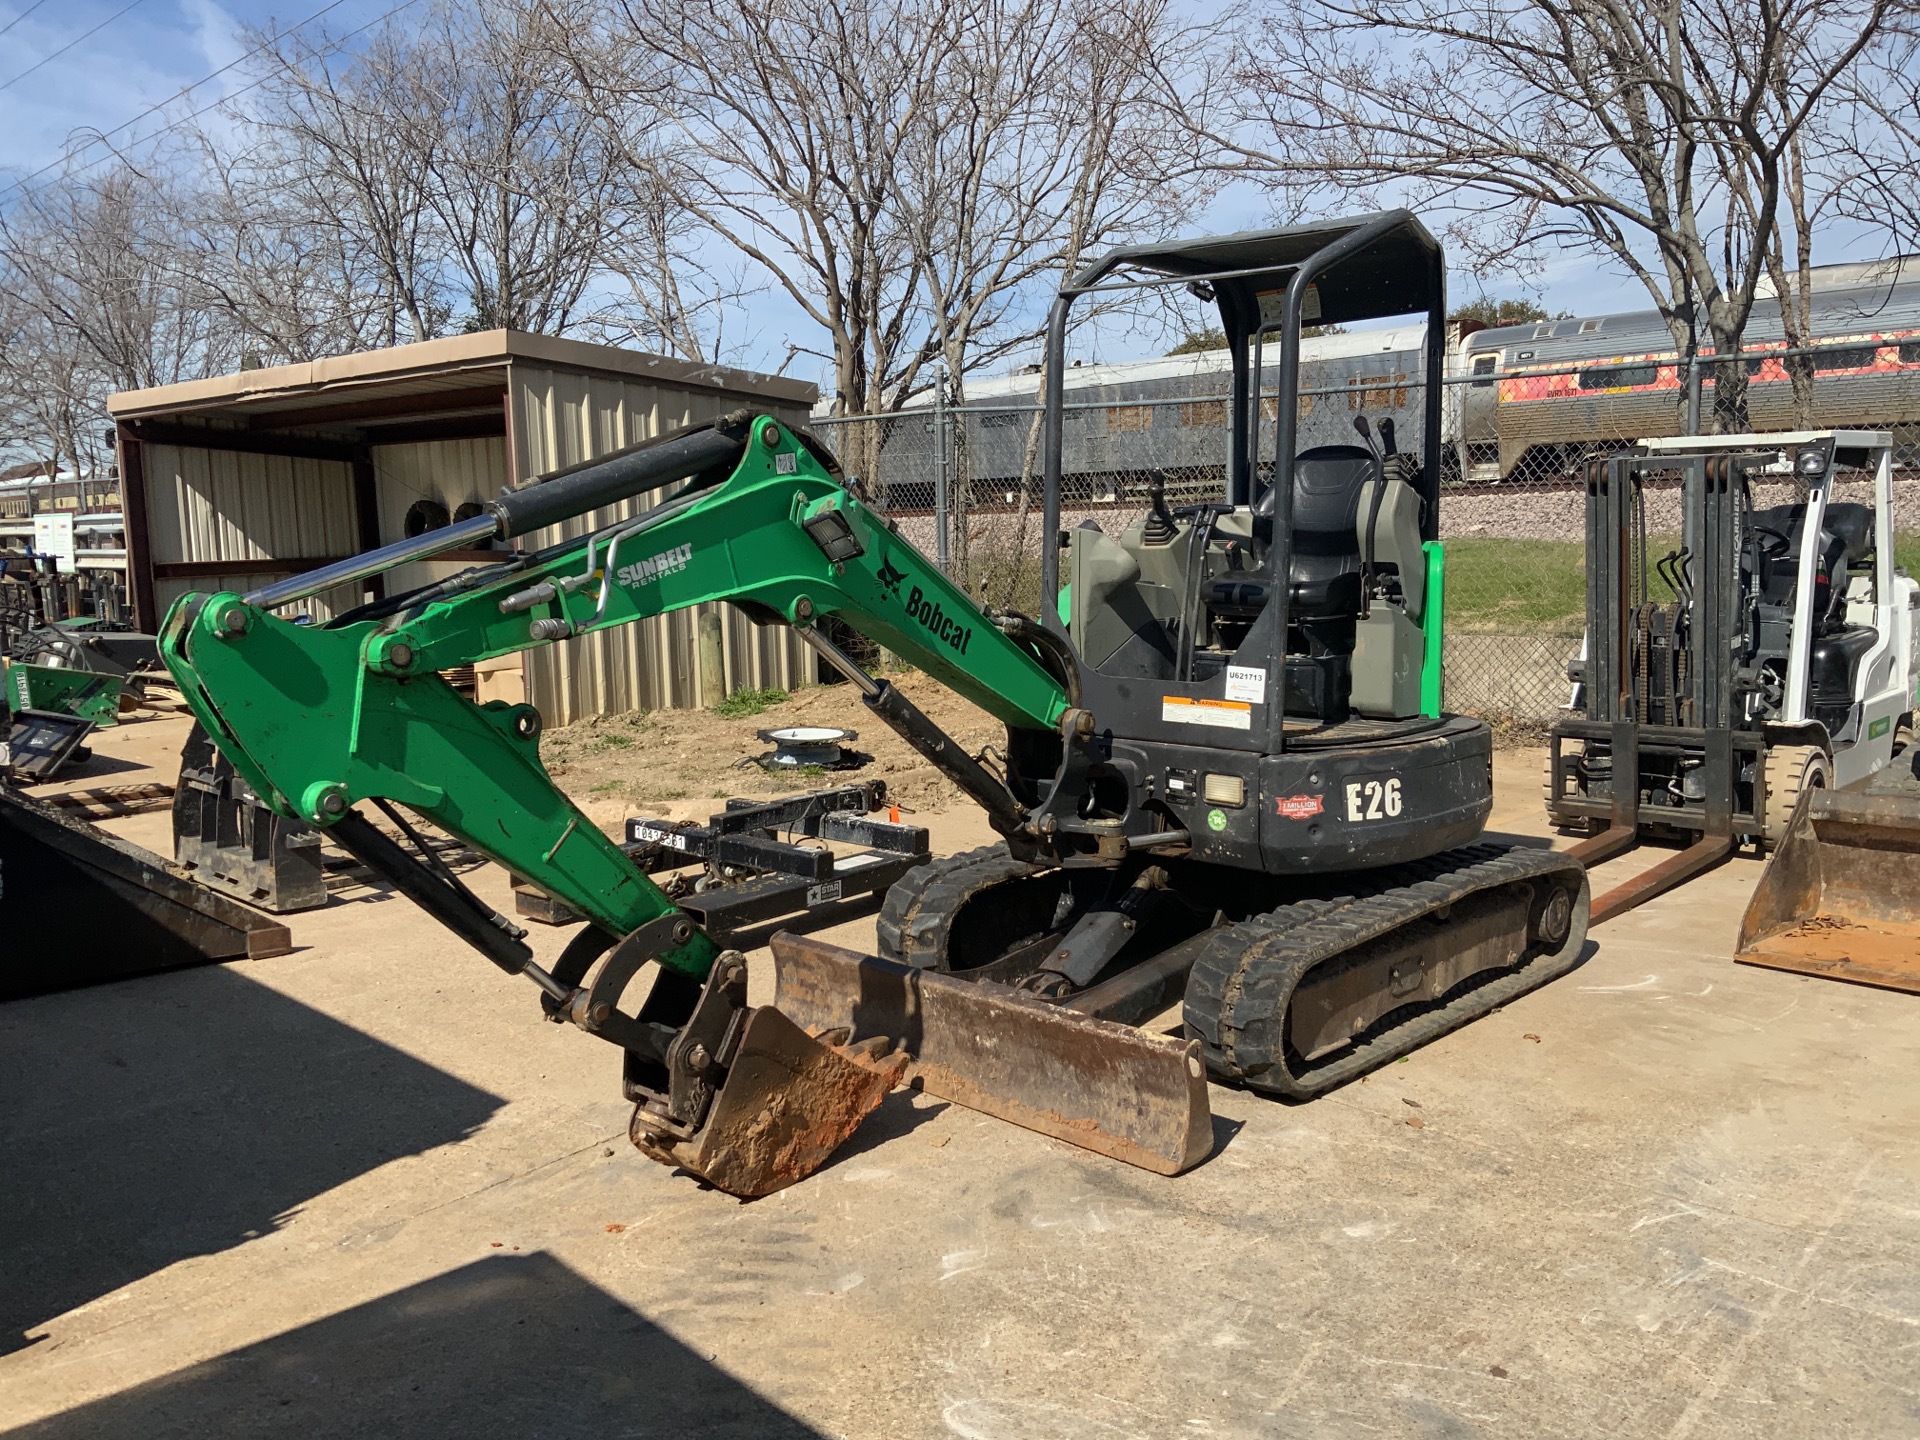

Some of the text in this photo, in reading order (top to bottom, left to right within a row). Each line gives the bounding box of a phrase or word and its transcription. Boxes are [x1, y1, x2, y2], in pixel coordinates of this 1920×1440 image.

[617, 542, 692, 586] SUNBELT
[632, 562, 687, 590] RENTALS
[904, 584, 972, 656] Bobcat
[1229, 672, 1263, 682] U621713
[1287, 801, 1317, 809] MILLION
[1346, 777, 1402, 822] E26
[821, 883, 839, 894] STAR
